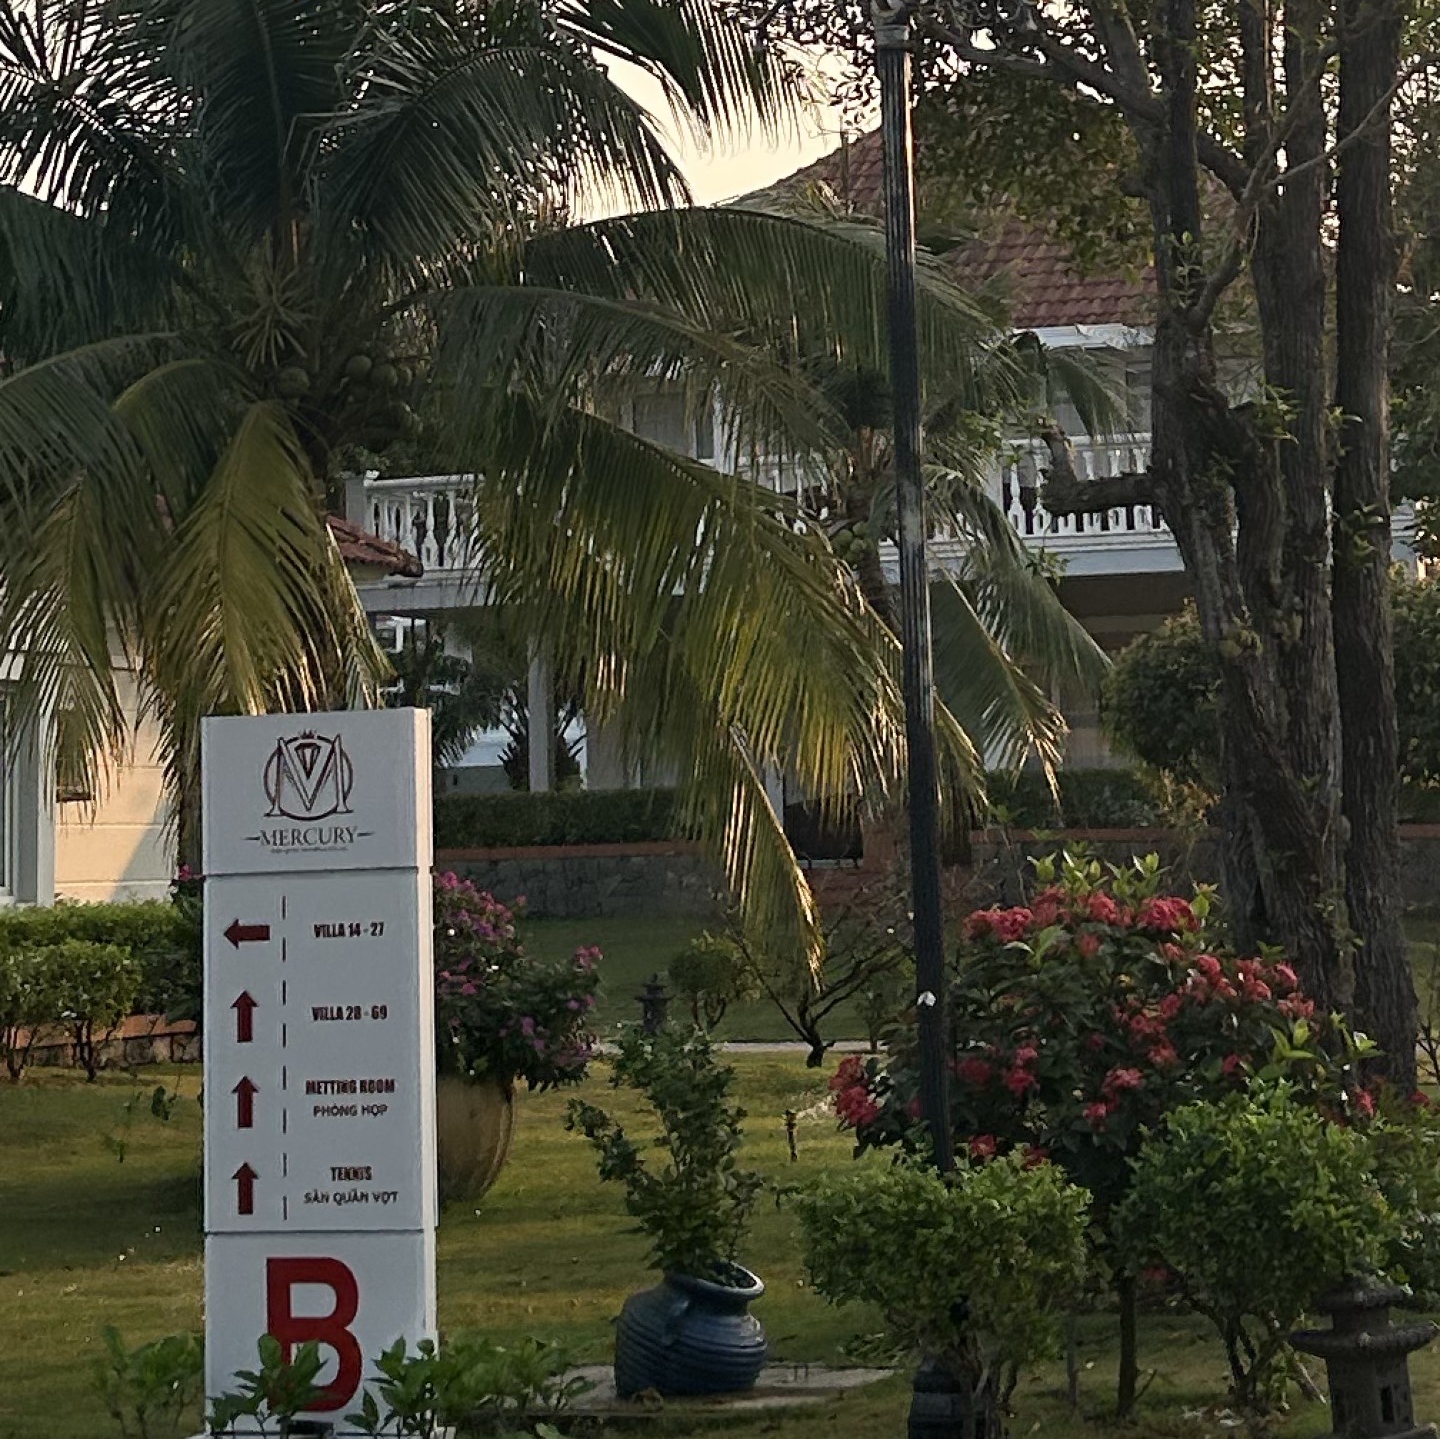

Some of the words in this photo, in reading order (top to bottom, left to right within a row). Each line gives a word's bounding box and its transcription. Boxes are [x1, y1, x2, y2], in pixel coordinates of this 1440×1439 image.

[259, 825, 358, 847] MERCURY
[313, 922, 346, 938] VILLA
[347, 922, 361, 937] 14
[370, 921, 385, 937] 27
[311, 1005, 344, 1021] VILLA
[345, 1005, 362, 1021] 28
[371, 1005, 388, 1020] 69
[359, 1078, 395, 1094] ROOM
[266, 1256, 363, 1413] B
